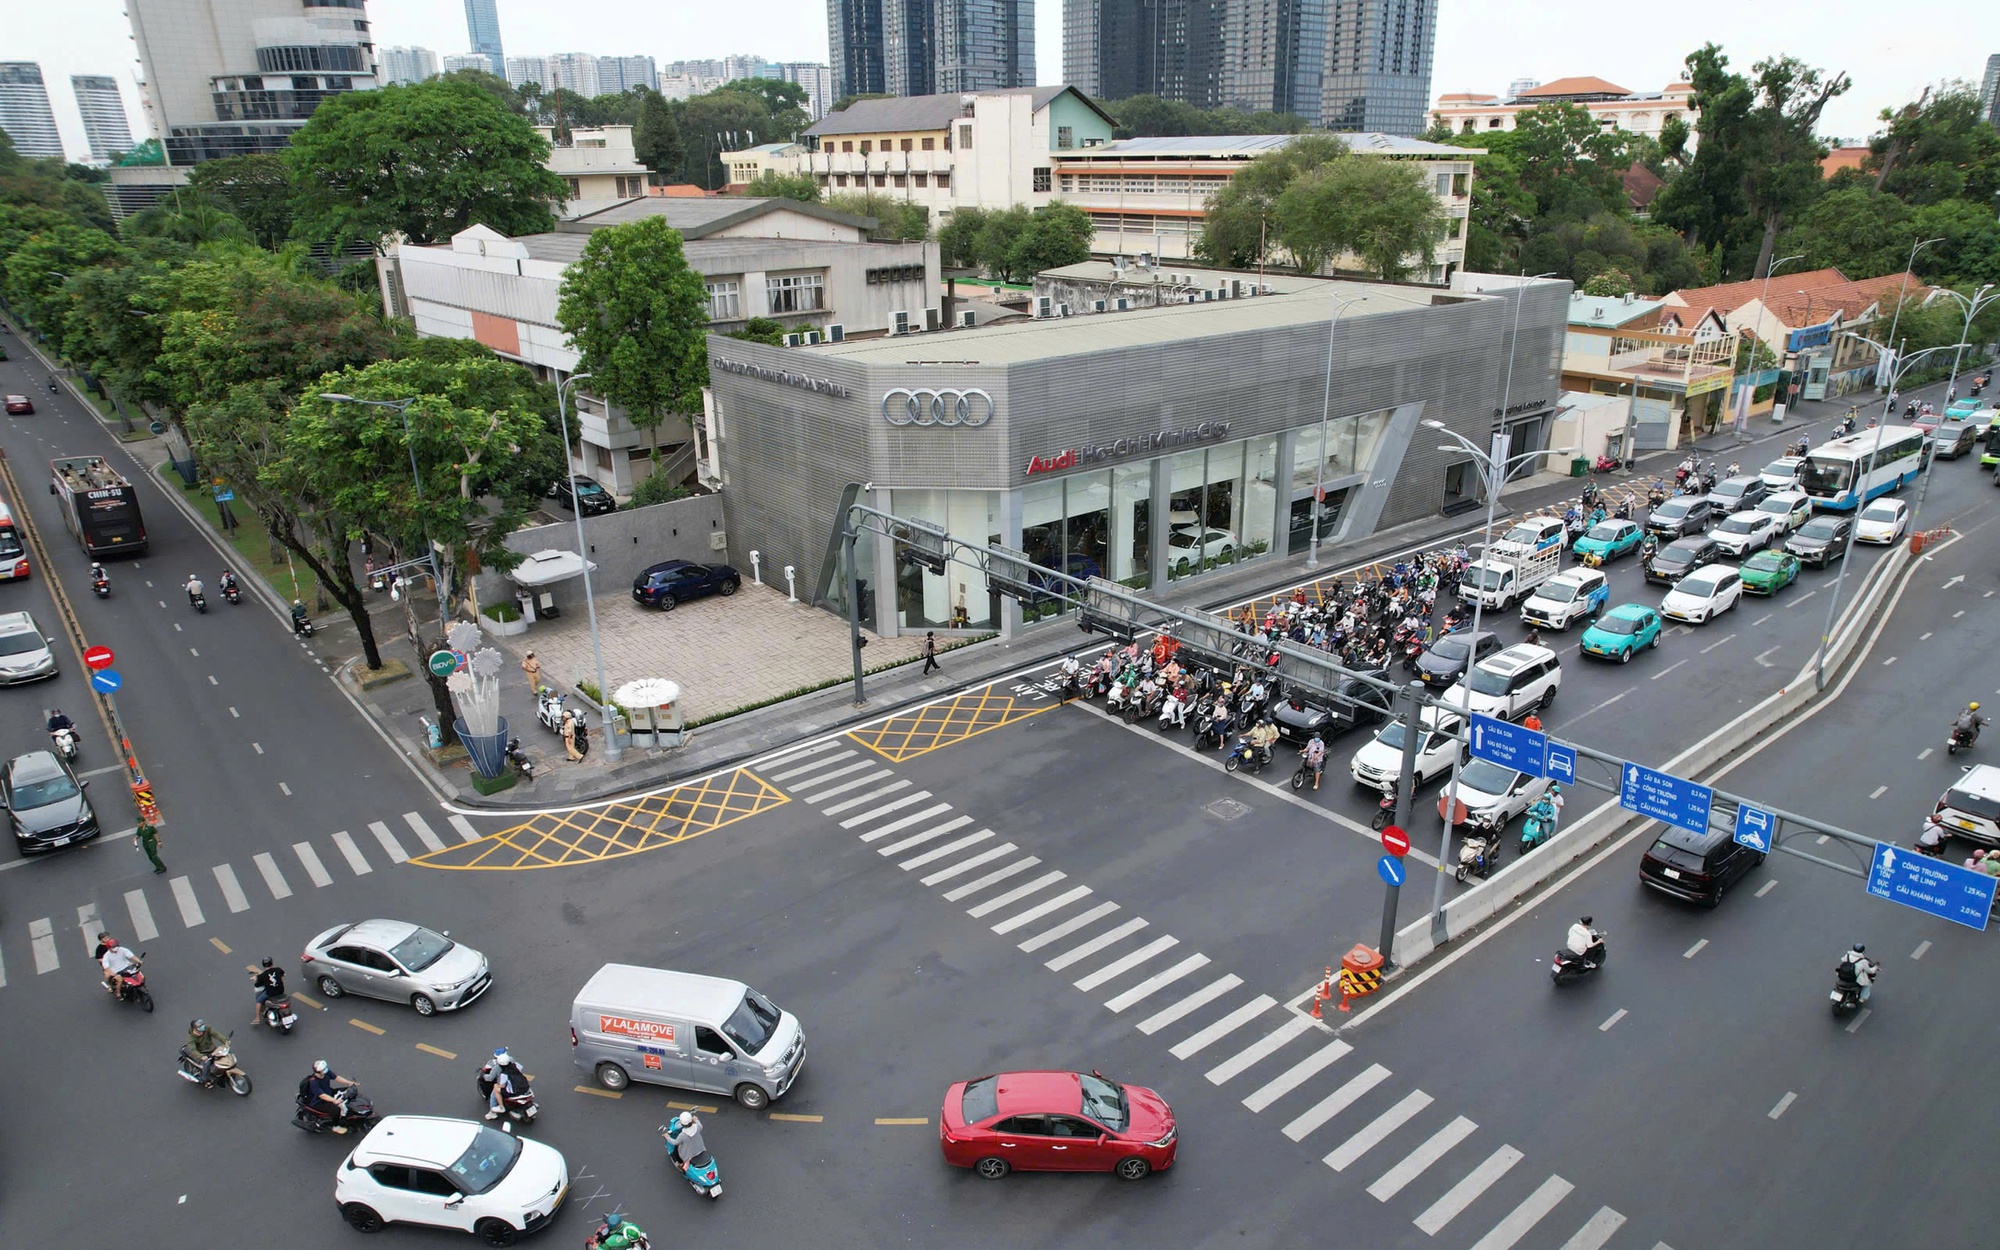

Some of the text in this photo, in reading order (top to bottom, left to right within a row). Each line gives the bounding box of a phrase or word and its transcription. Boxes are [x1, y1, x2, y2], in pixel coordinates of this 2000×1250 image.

[1026, 421, 1231, 474] Audi Ho Chi Minh City
[88, 489, 122, 499] CHIN-SU
[1642, 784, 1656, 794] CÔNG
[1662, 780, 1673, 788] SON
[1699, 791, 1708, 800] Km
[1656, 798, 1669, 806] LINH
[1697, 806, 1705, 814] Km
[1694, 820, 1703, 828] Km
[1902, 861, 1920, 873] CÔNG
[1909, 873, 1936, 887] MÊ LINH
[1910, 889, 1934, 903] KHÁNH
[1964, 886, 1987, 899] 1.25 Km
[1960, 906, 1981, 918] 2.0 Km
[613, 1019, 673, 1036] LALAMOVE
